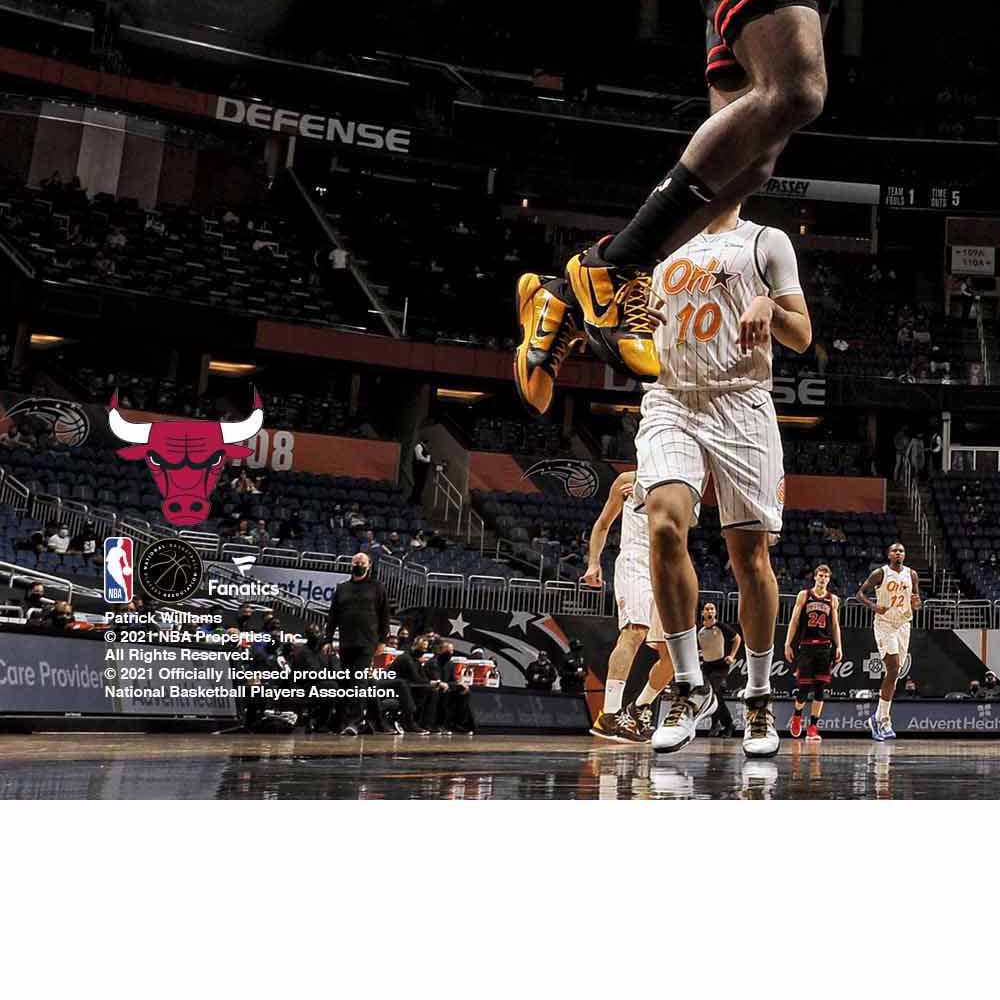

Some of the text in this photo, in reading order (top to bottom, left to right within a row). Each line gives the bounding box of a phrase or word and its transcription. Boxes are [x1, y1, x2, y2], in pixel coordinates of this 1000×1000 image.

[215, 95, 412, 154] DEFENSE
[766, 177, 810, 195] ASSEY
[907, 187, 916, 206] 1
[951, 190, 961, 207] 5
[675, 301, 723, 345] 10
[807, 611, 827, 629] 24
